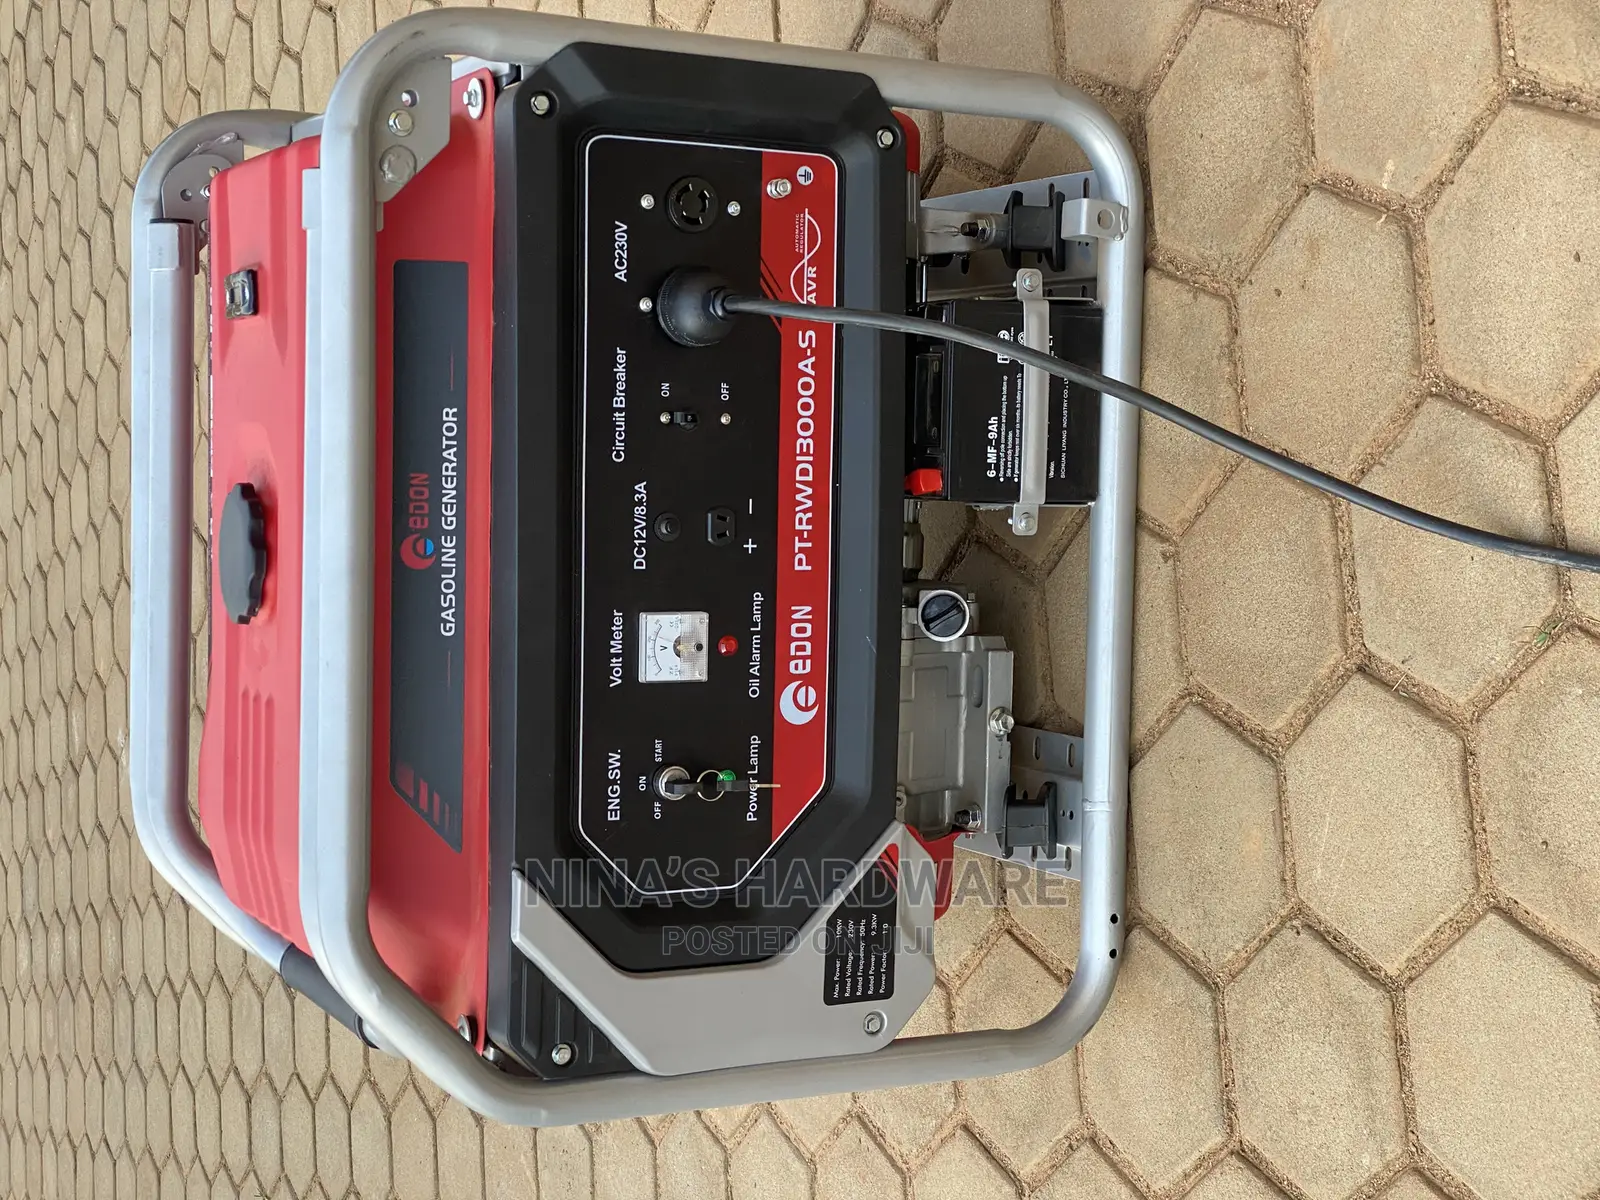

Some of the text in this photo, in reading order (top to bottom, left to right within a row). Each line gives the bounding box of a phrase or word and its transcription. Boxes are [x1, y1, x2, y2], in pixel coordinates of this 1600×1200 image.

[614, 221, 629, 282] AC230V
[807, 266, 817, 304] AVR
[612, 347, 628, 462] Circuit Breaker
[661, 383, 670, 397] ON
[721, 383, 730, 400] OFF
[440, 408, 458, 636] GASOLINE GENERATOR
[633, 481, 648, 570] DC12V/8.3A
[610, 610, 623, 687] Volt Meter
[748, 592, 764, 698] Oil Alarm Lamp
[654, 739, 663, 762] START
[746, 735, 761, 821] Power Lamp
[608, 750, 621, 821] ENG.SW.
[638, 776, 647, 791] ON
[654, 802, 662, 819] OFF
[857, 940, 865, 975] Frequency:
